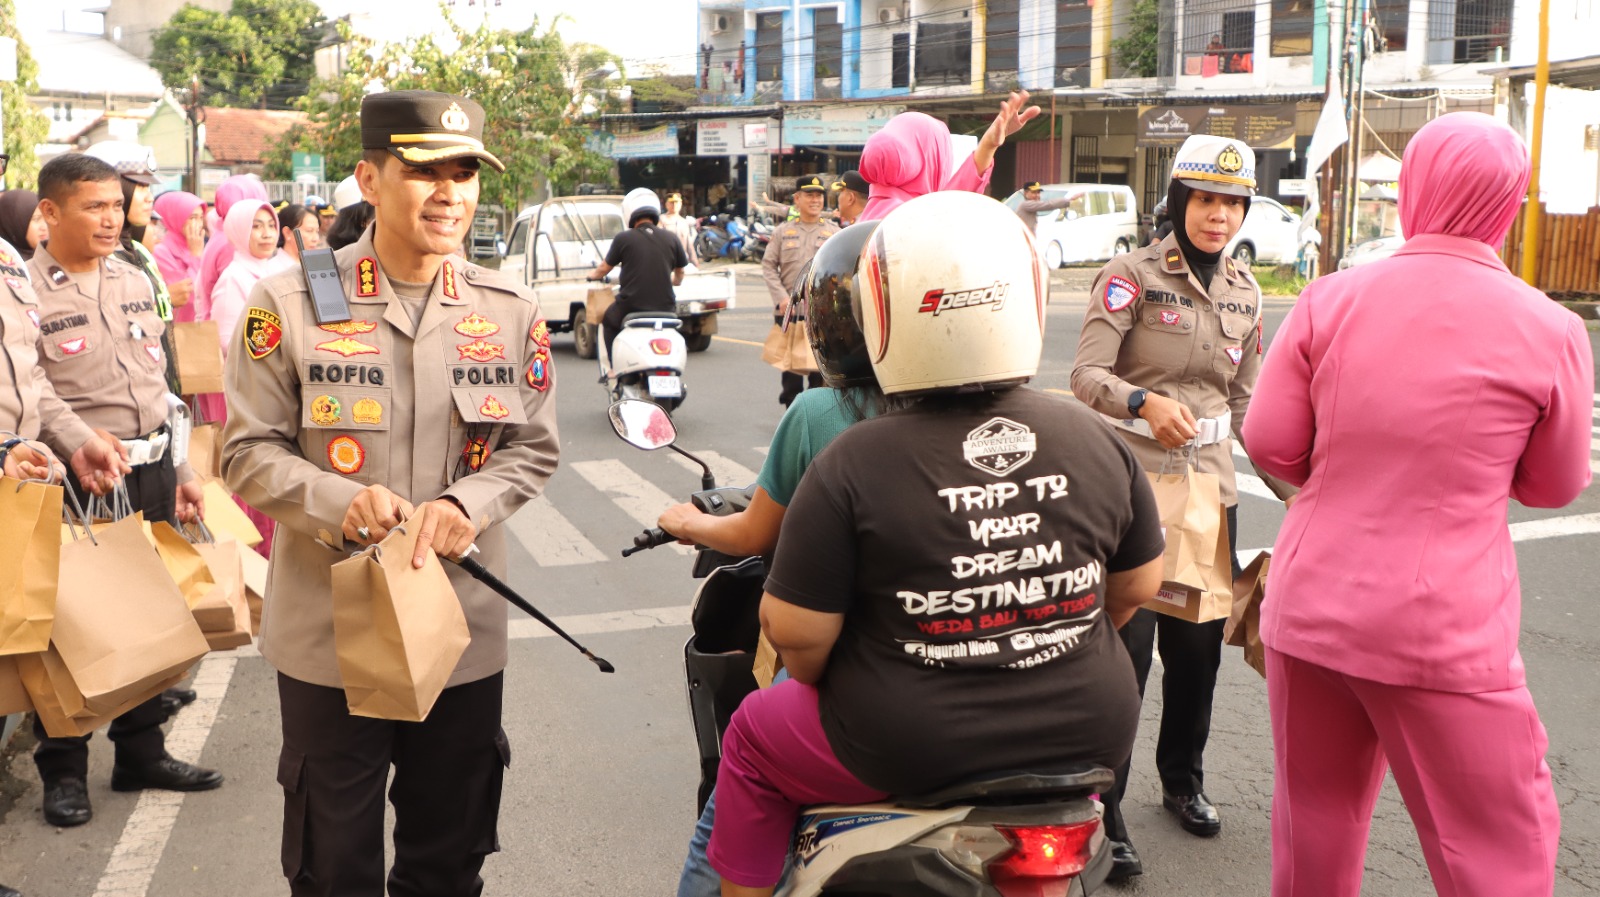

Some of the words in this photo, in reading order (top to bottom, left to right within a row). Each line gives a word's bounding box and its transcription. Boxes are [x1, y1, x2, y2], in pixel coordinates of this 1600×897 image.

[918, 280, 1010, 317] Speedy
[1145, 289, 1178, 304] ENITA
[1179, 295, 1194, 309] DR
[1217, 301, 1255, 318] POLRI
[309, 363, 385, 386] ROFIQ
[452, 366, 515, 386] POLRI
[970, 435, 1029, 449] ADVENTURE
[982, 444, 1018, 455] AWAITS
[937, 481, 1020, 514] TRIP
[1025, 474, 1069, 501] TO
[967, 512, 1041, 548] YOUR
[950, 540, 1063, 580] DREAM
[896, 559, 1102, 616] DESTINATION
[917, 617, 975, 635] WEDA
[978, 609, 1018, 630] BALI
[1059, 593, 1096, 614] TOUR
[927, 642, 968, 661] Ngurah
[968, 639, 1001, 657] Weda
